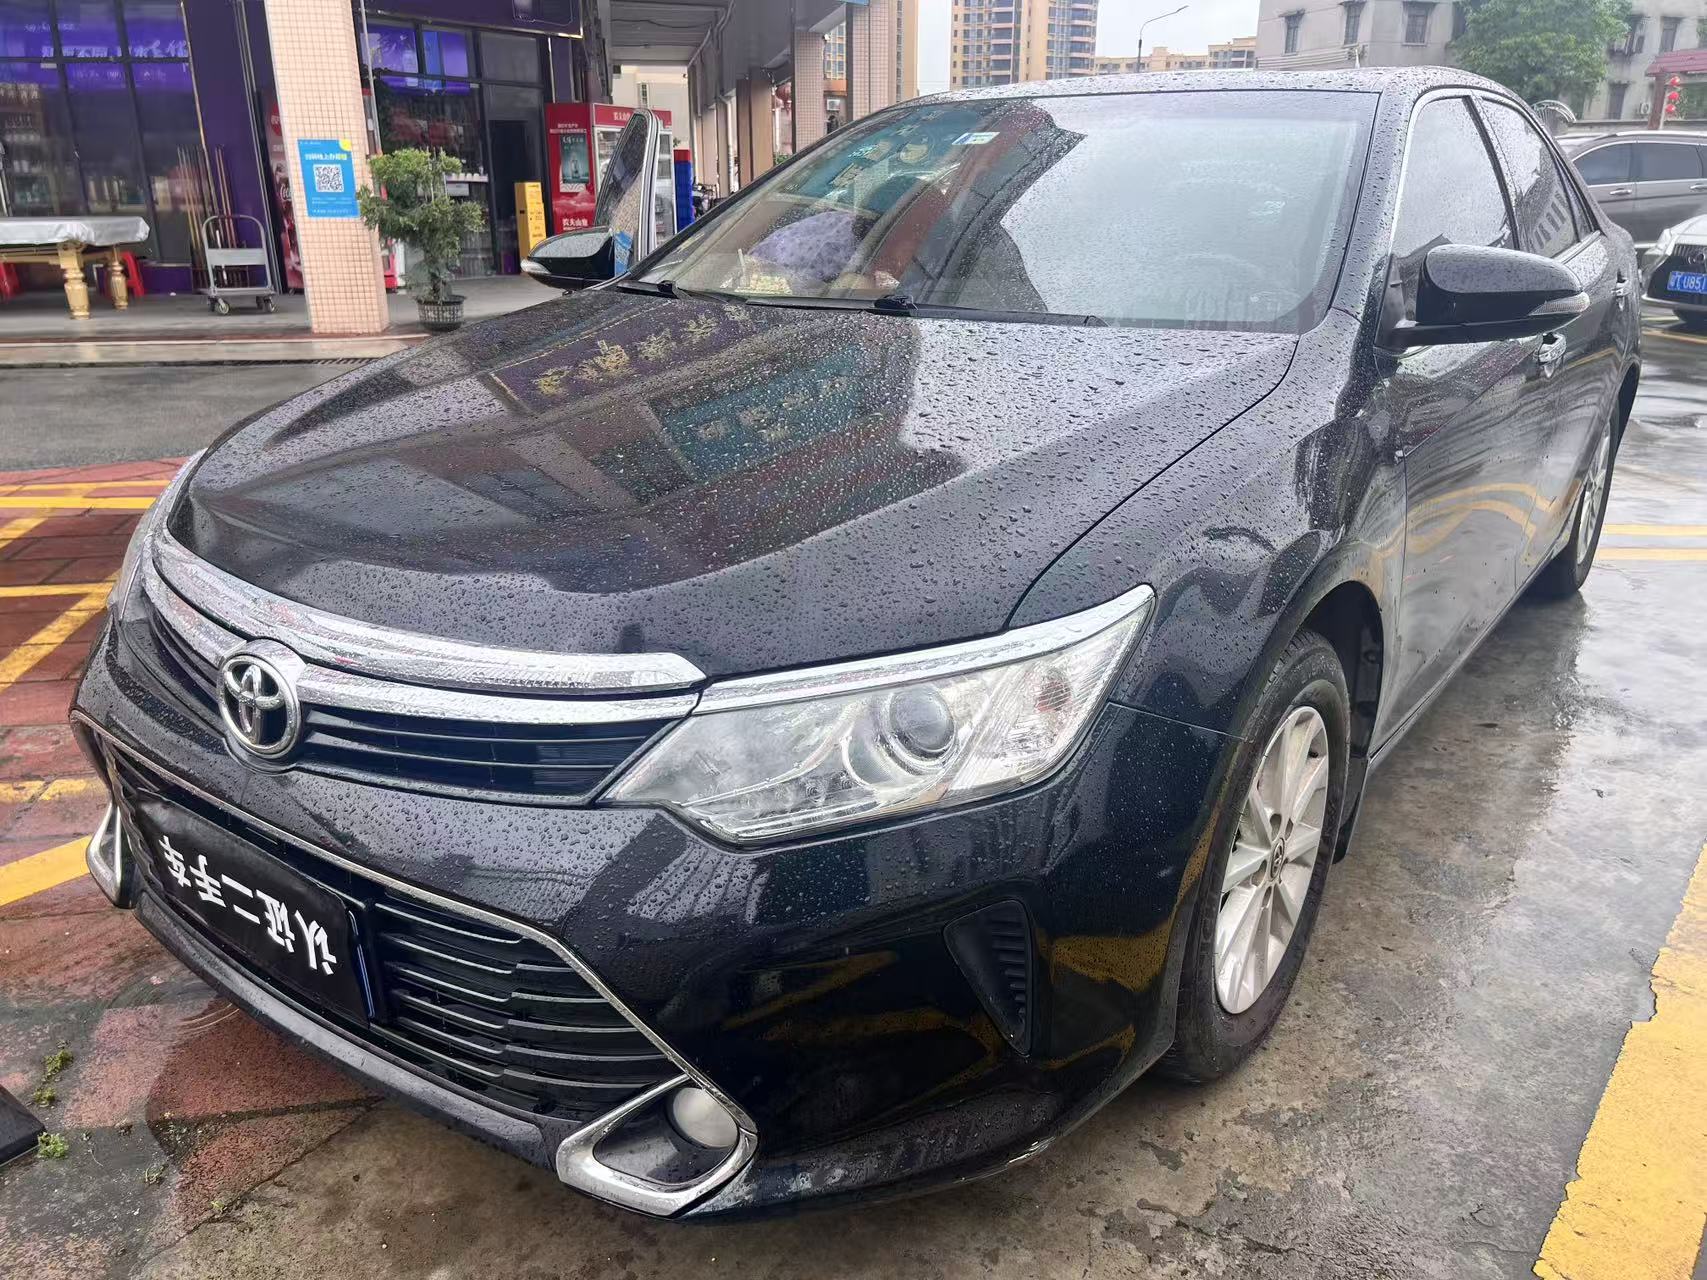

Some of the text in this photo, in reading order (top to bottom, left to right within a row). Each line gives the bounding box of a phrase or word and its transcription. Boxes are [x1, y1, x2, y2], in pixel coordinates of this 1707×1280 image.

[159, 835, 337, 975] 认证二手车
